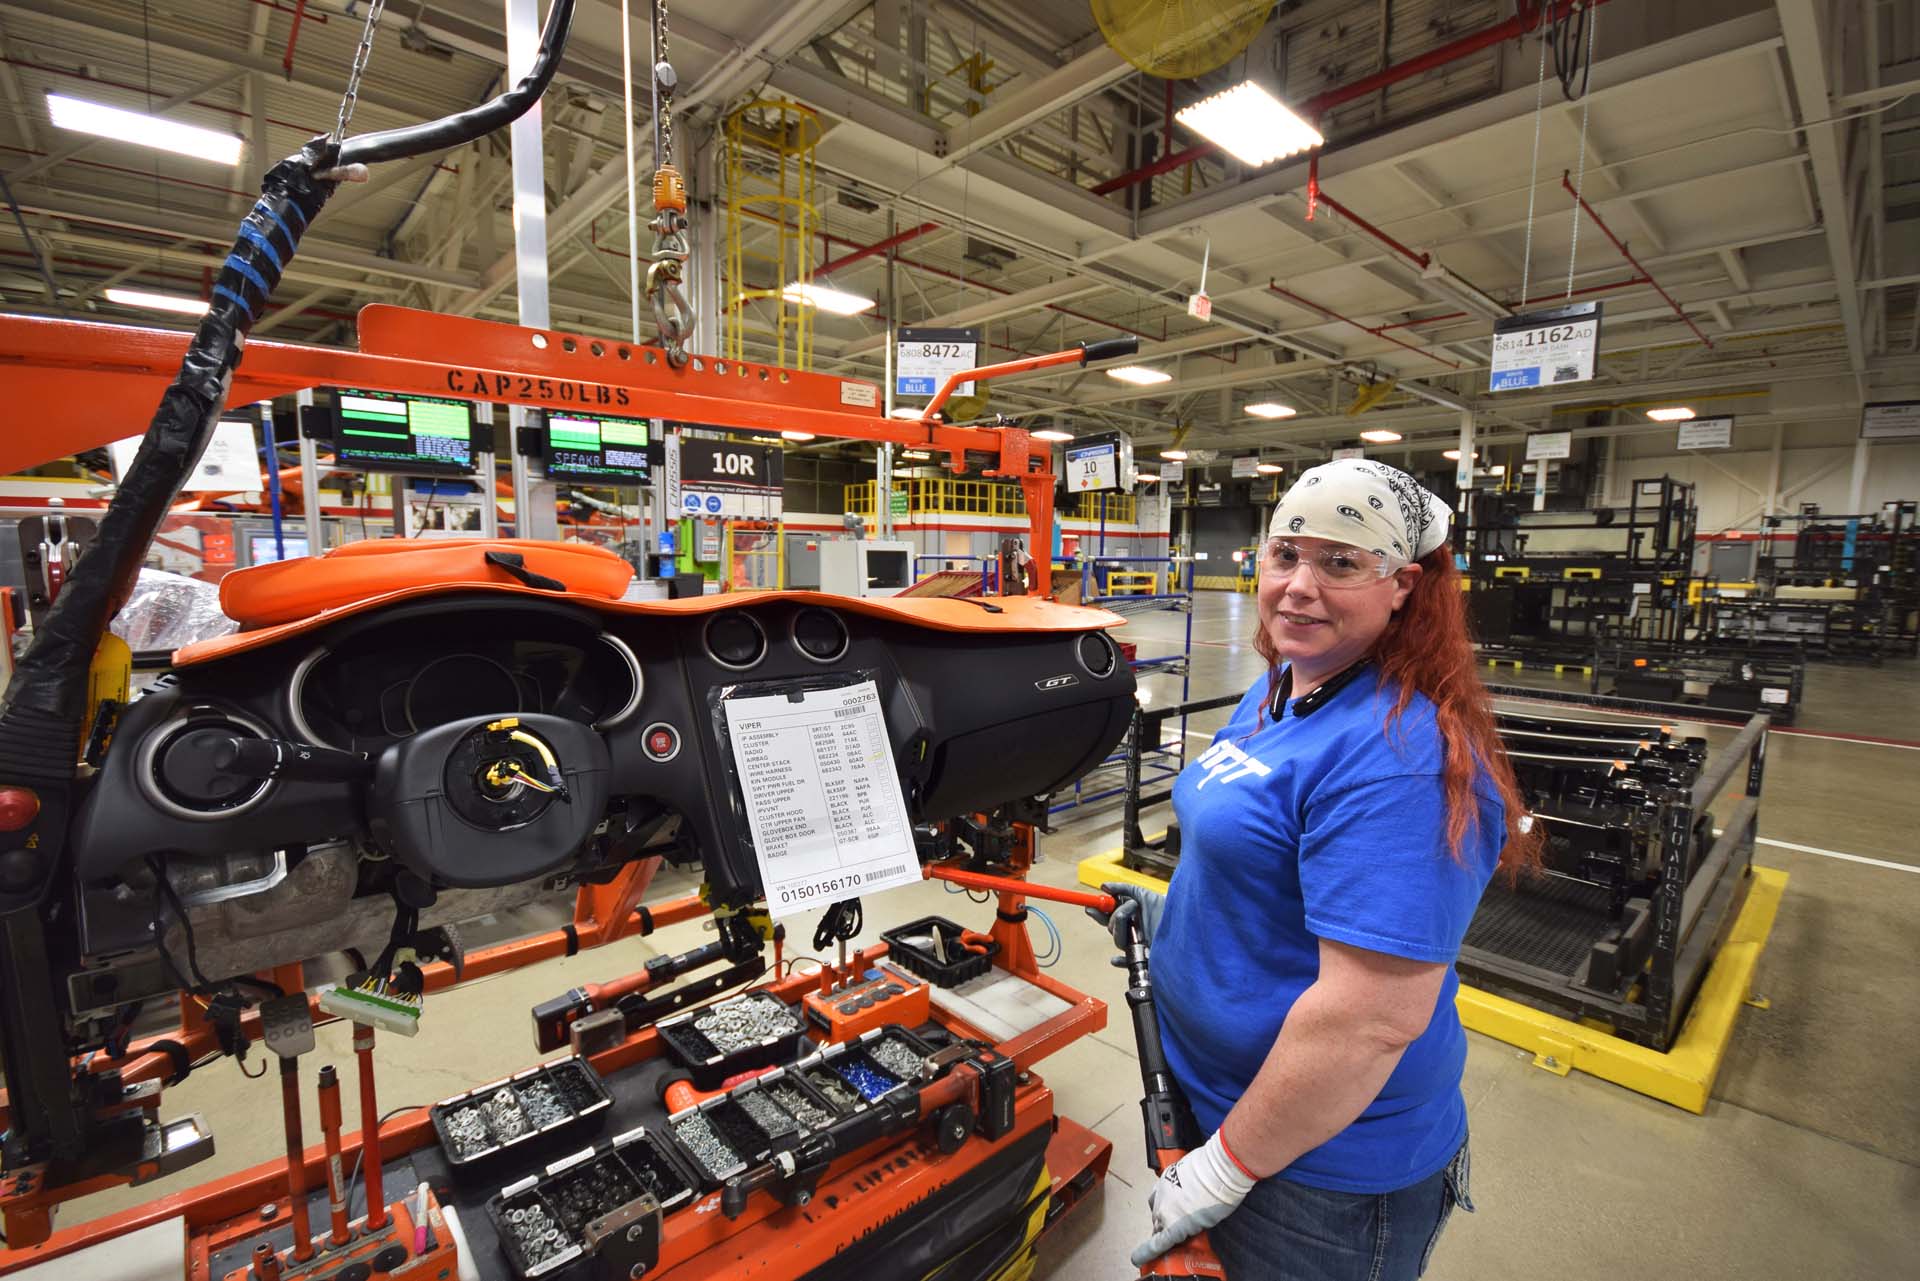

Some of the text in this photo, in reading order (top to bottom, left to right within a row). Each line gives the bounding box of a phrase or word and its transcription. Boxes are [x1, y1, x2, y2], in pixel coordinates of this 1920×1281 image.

[1500, 376, 1529, 387] BLUE
[904, 384, 928, 392] BLUE
[712, 452, 755, 476] 10R
[1084, 461, 1097, 474] 10
[1046, 676, 1072, 687] GT
[843, 693, 876, 706] 0002763
[739, 722, 762, 730] VIPER
[746, 755, 768, 763] AIRBAG
[748, 762, 770, 770] CENTER
[754, 791, 775, 799] DRIVER
[758, 812, 785, 821] CLUSTER
[773, 819, 792, 827] UPPER
[762, 826, 794, 836] GLOVEBOX
[764, 836, 784, 844] GLOVE
[798, 829, 816, 837] DOOR
[767, 850, 787, 858] BADGE
[781, 874, 861, 903] 0150156170
